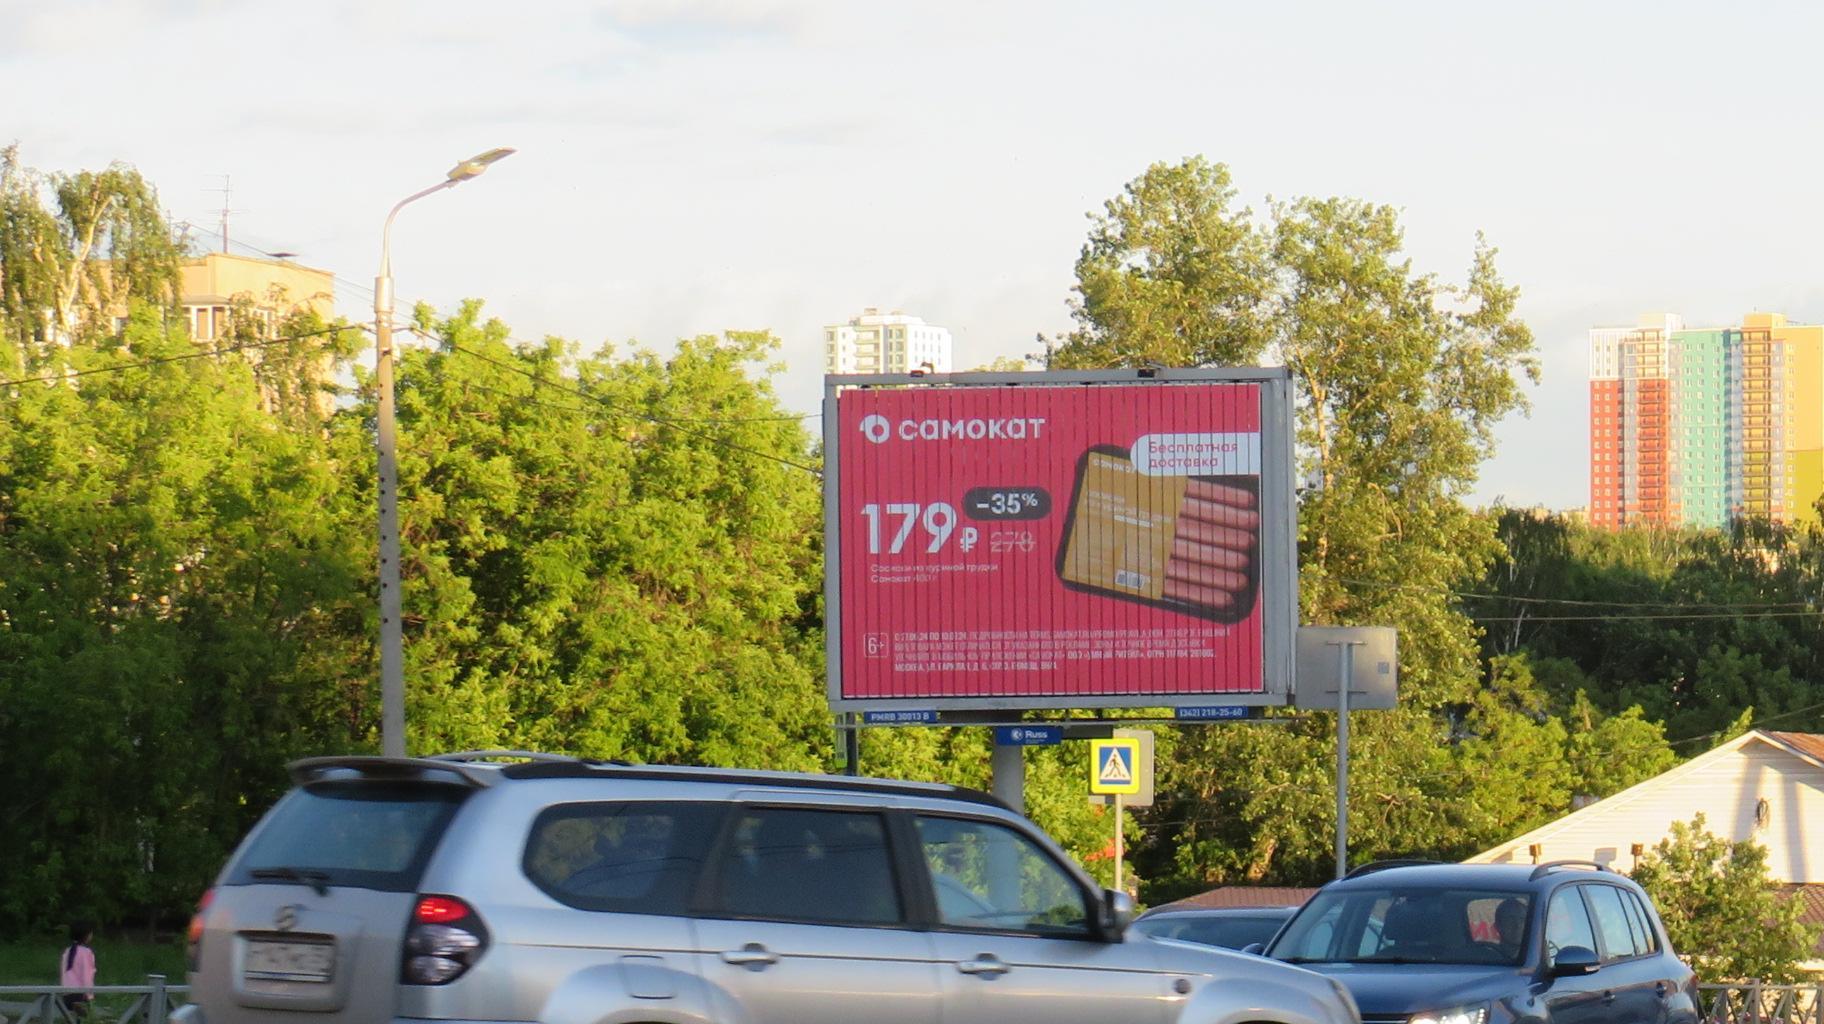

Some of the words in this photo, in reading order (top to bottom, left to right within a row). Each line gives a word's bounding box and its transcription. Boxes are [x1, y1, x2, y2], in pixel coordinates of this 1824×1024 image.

[898, 417, 1046, 441] самокат
[1148, 440, 1238, 454] Бесплатная
[1148, 457, 1218, 470] доставка
[867, 637, 885, 654] 6+
